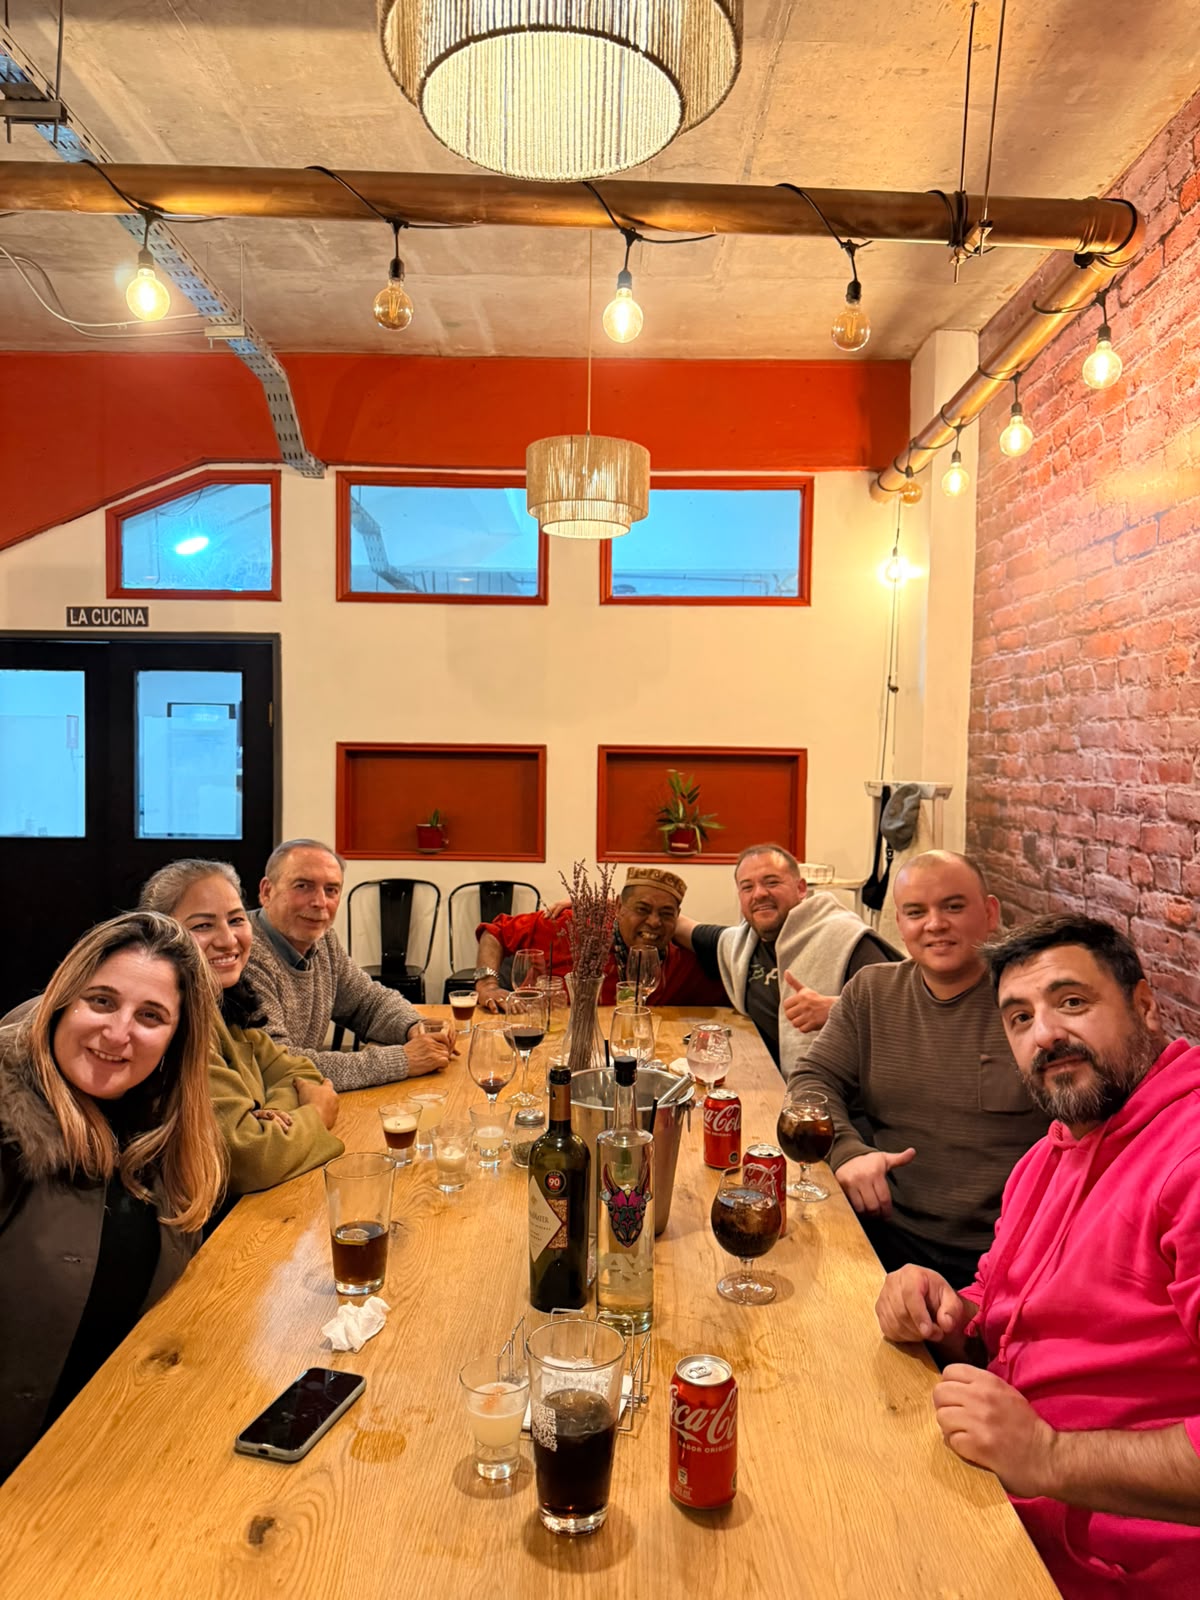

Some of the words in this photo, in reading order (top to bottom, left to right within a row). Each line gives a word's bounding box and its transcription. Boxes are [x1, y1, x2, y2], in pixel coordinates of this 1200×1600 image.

[70, 608, 88, 625] LA
[91, 608, 146, 625] CUCINA
[548, 1177, 561, 1187] 90
